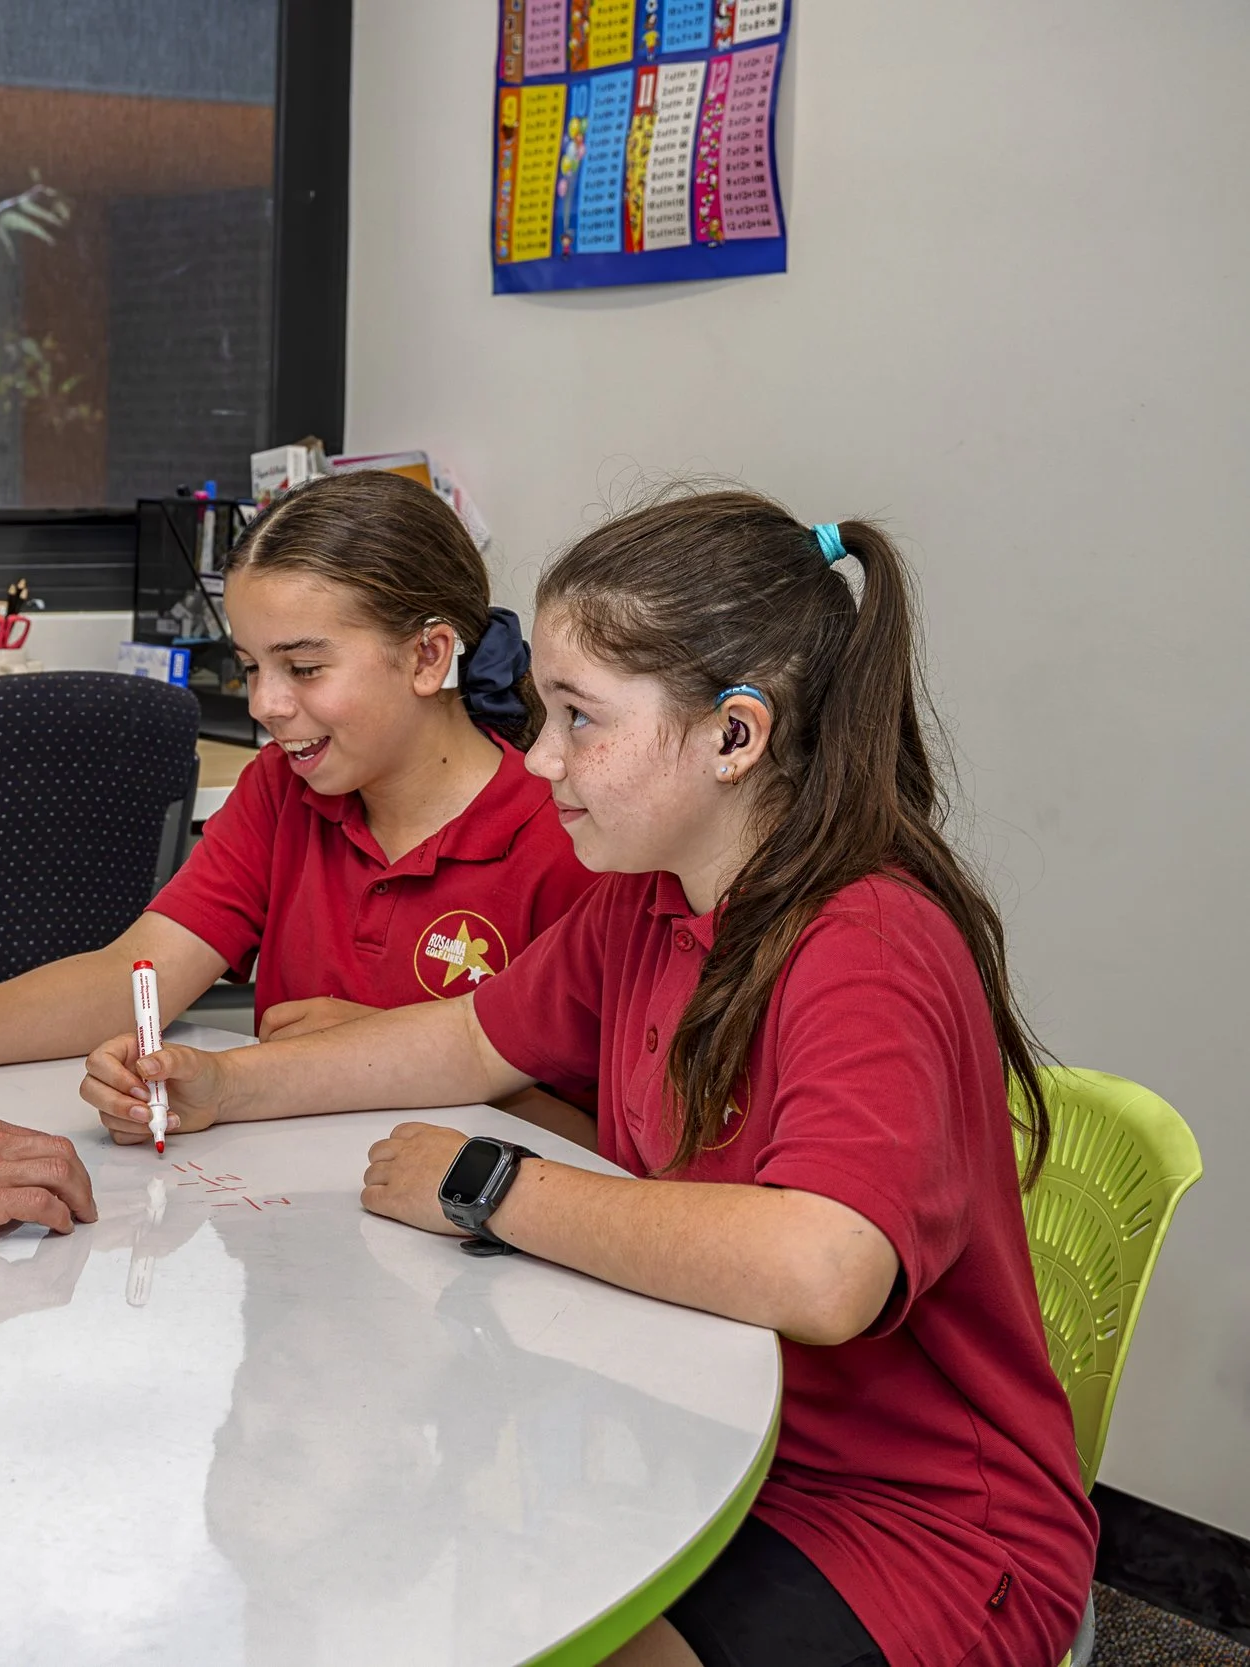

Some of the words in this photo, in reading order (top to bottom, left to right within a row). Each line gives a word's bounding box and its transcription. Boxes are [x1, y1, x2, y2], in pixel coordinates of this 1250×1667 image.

[425, 946, 444, 960] GOLF
[443, 950, 464, 966] LINKS
[428, 932, 466, 958] ROSANNA
